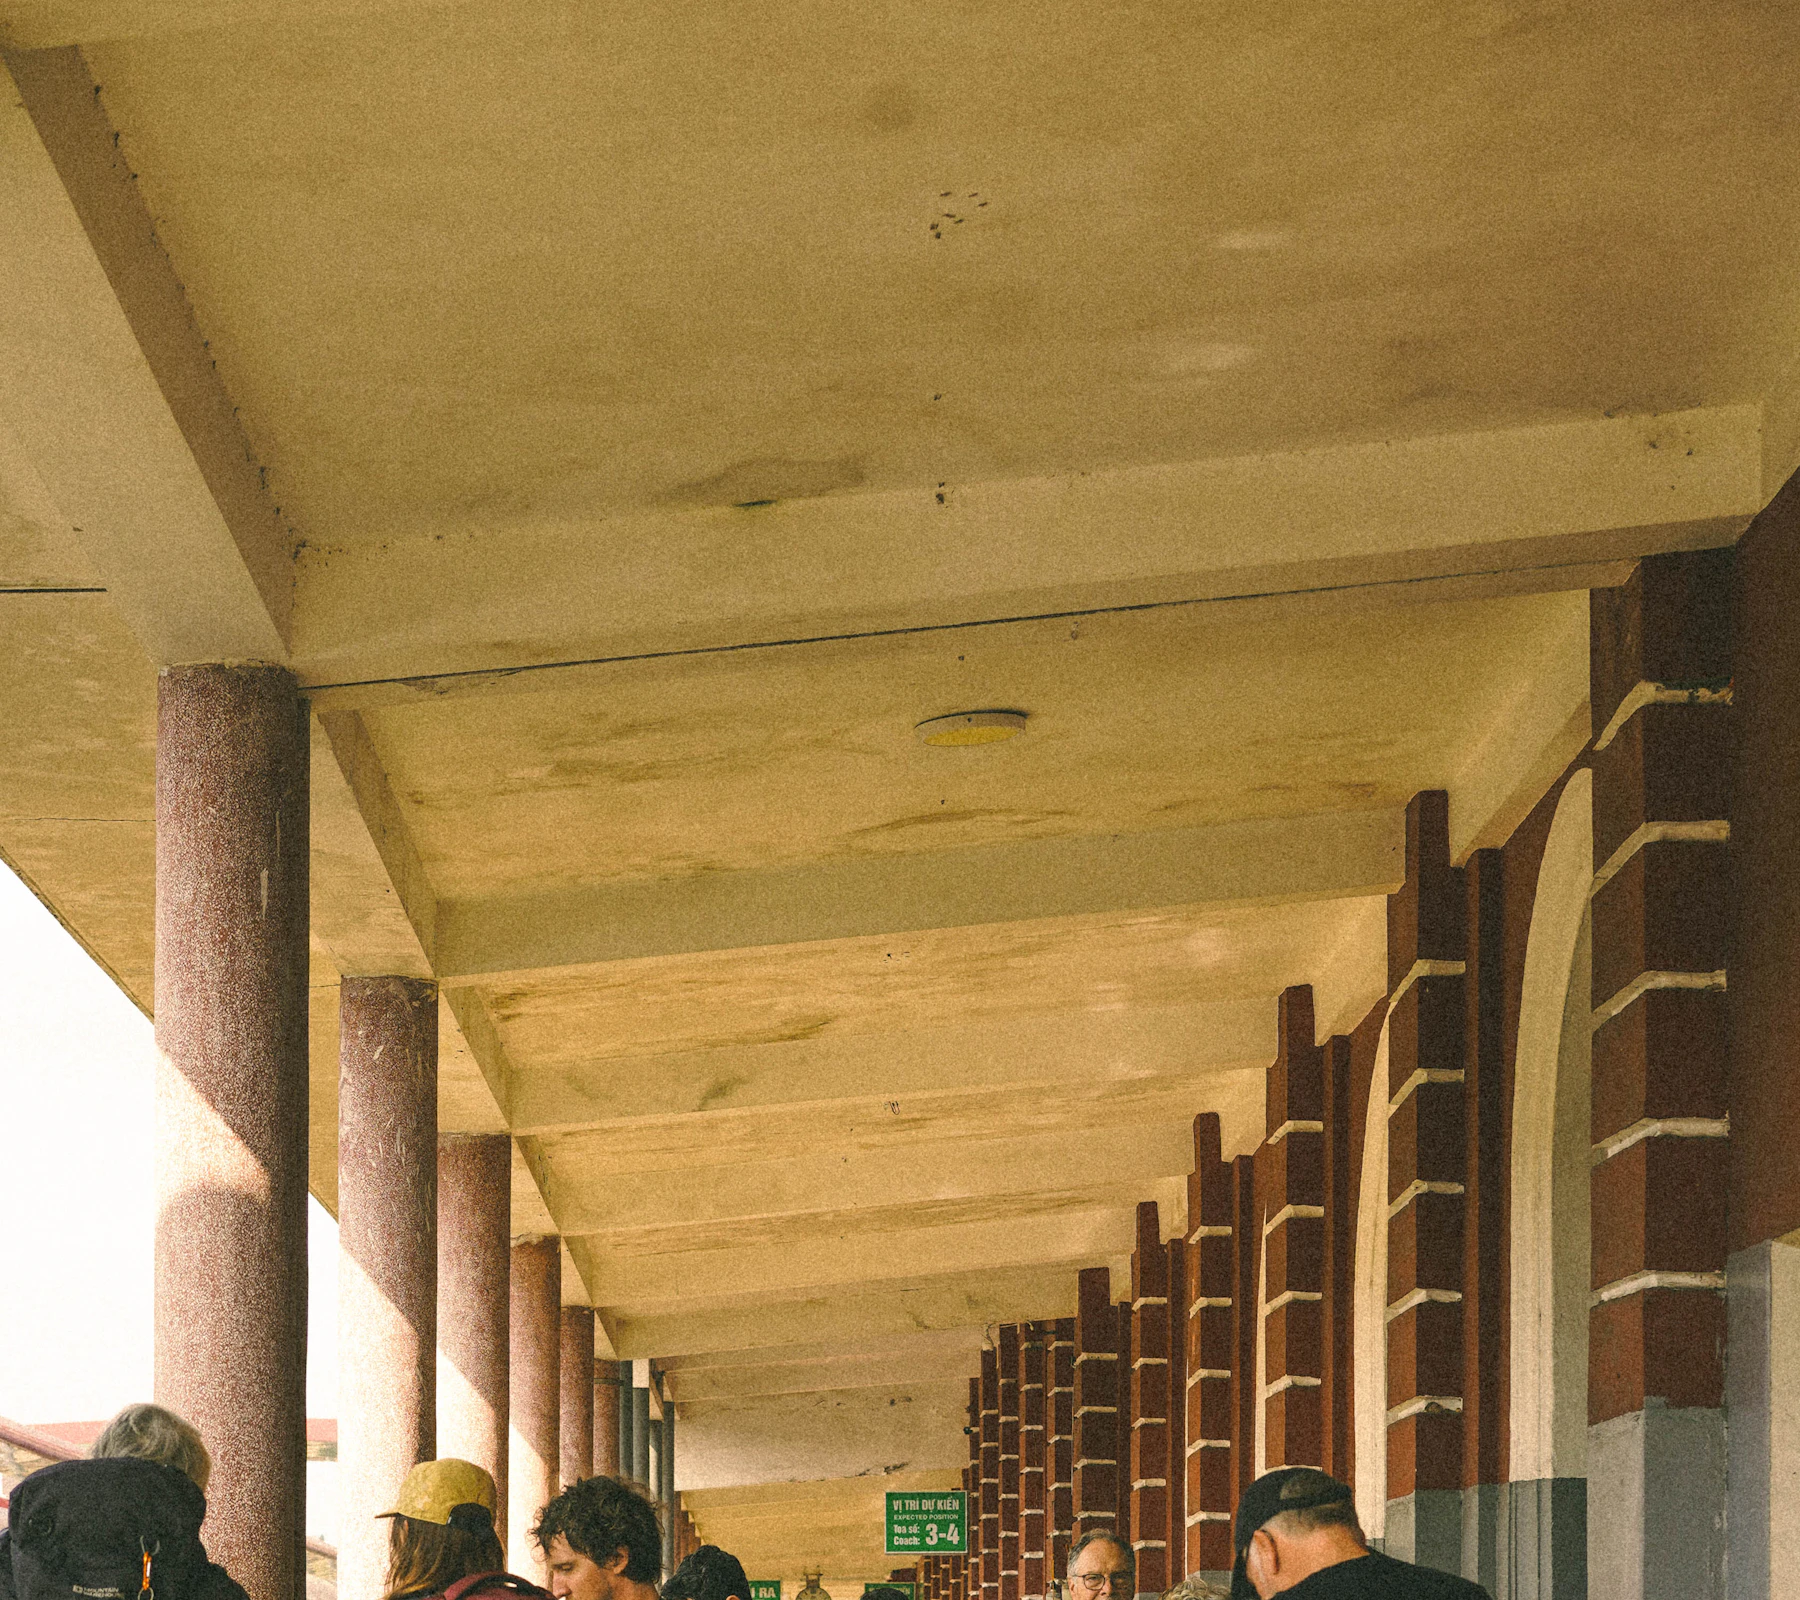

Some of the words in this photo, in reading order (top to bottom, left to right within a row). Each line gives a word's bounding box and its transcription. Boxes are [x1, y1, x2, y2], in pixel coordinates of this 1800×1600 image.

[893, 1499, 902, 1513] VỊ
[904, 1497, 919, 1510] TRÍ
[921, 1498, 936, 1513] DỰ
[937, 1495, 959, 1510] KIẾN
[893, 1524, 907, 1534] Toa
[908, 1522, 920, 1534] số:
[925, 1523, 960, 1545] 3-4
[893, 1535, 920, 1546] Coach:
[759, 1587, 776, 1598] RA
